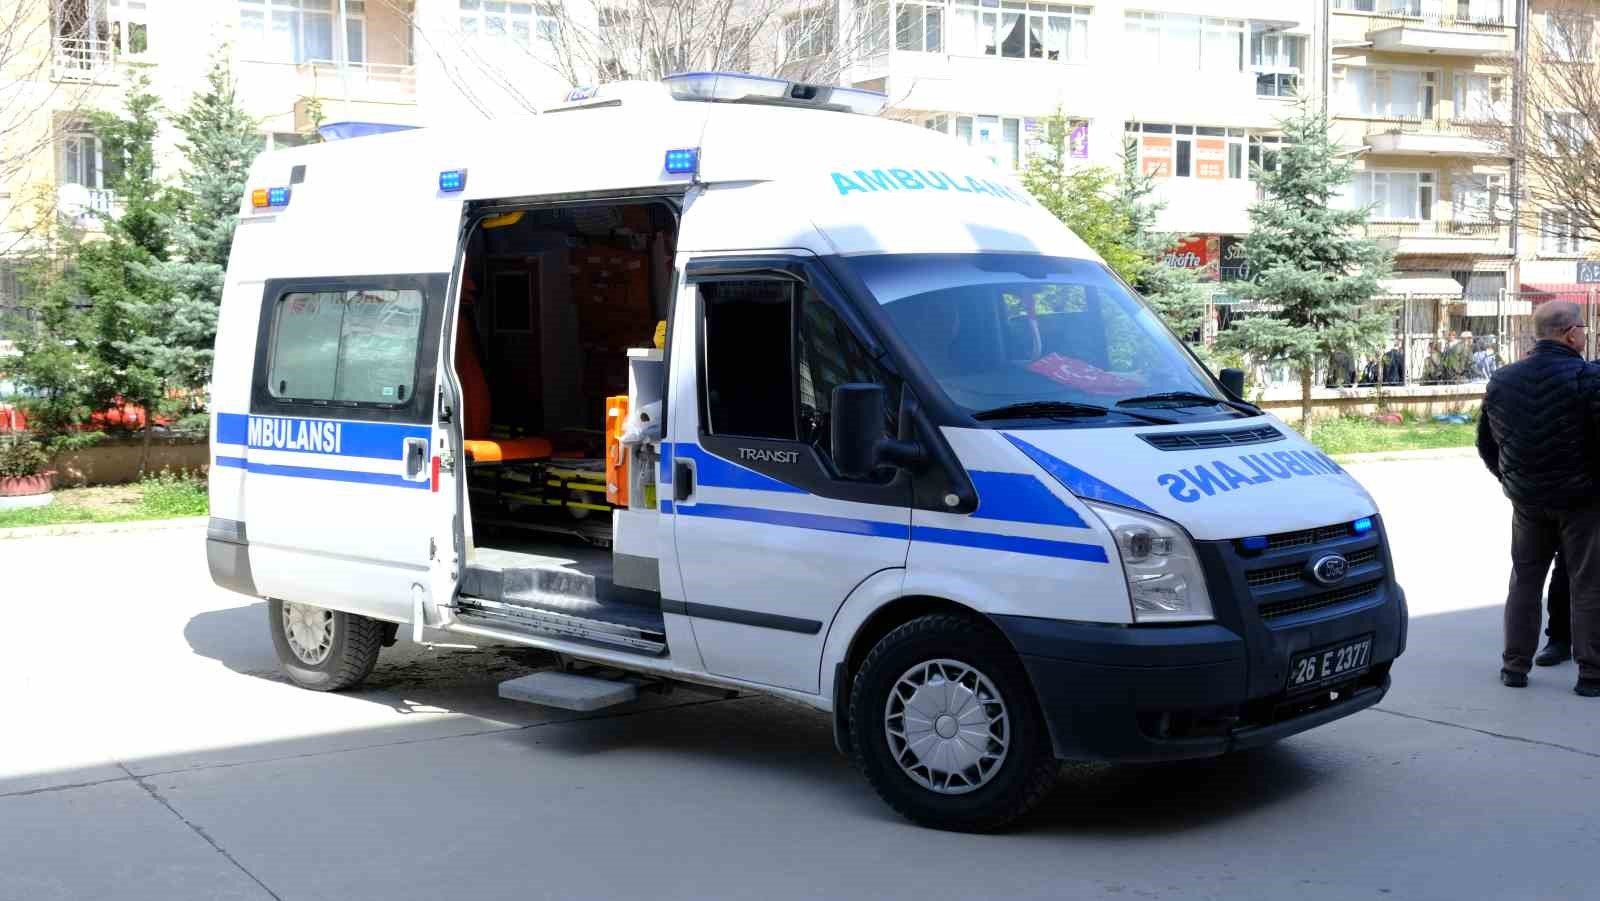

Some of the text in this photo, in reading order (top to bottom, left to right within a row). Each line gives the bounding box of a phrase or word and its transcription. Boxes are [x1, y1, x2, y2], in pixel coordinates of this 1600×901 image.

[248, 417, 342, 453] MBULANSI
[738, 447, 800, 464] TRANSIT
[1295, 640, 1371, 684] 26 E 2377
